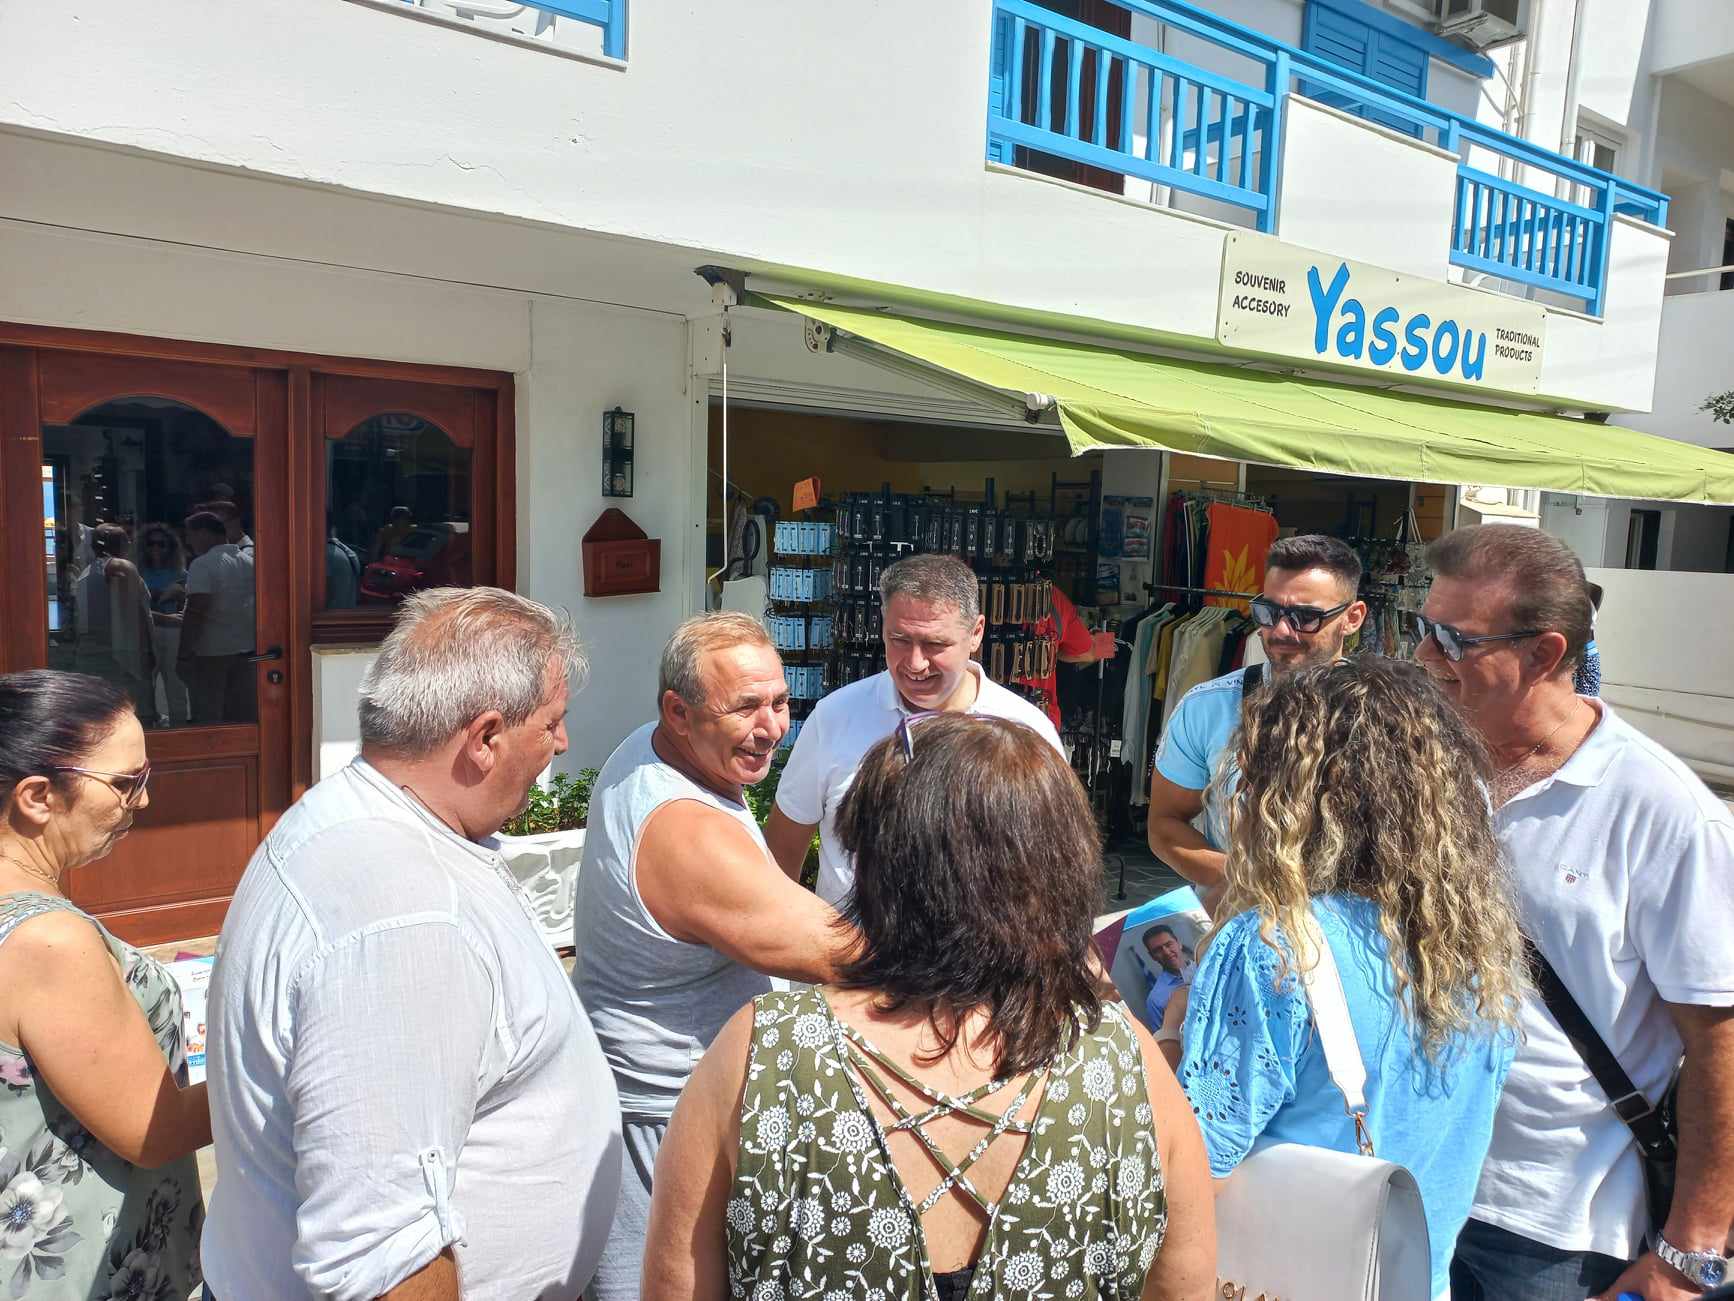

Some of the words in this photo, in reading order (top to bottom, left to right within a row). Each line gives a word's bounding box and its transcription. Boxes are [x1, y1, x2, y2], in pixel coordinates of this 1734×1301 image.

[1234, 270, 1286, 294] SOUVENIR
[1232, 295, 1291, 318] ACCESORY
[1307, 262, 1487, 381] Yassou
[1495, 328, 1540, 348] TRADITIONAL
[1494, 344, 1533, 362] PRODUCTS
